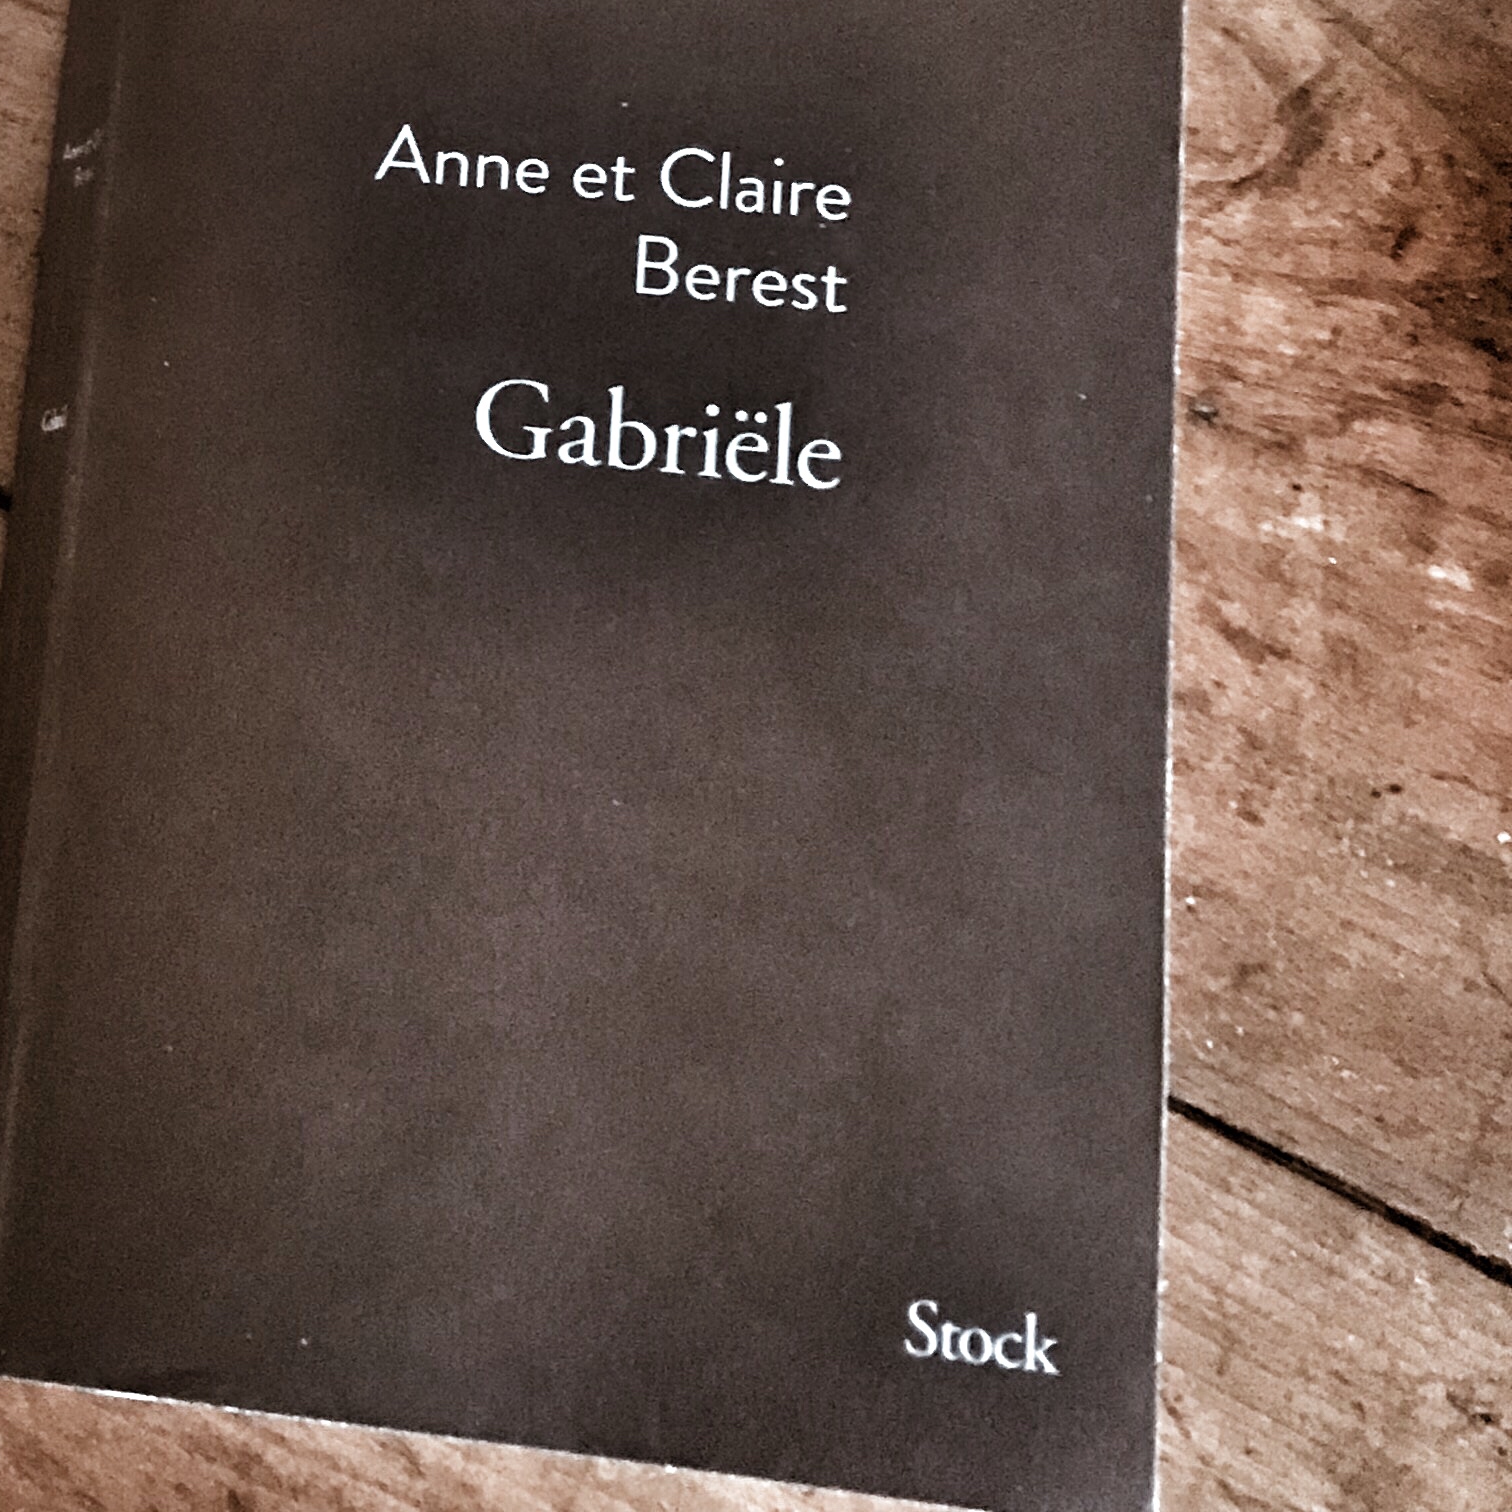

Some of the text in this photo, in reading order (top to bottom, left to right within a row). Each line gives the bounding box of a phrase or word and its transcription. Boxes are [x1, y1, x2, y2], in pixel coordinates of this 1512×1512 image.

[373, 122, 853, 222] Anne et Claire
[634, 233, 849, 314] Berest
[474, 378, 843, 491] Gabriële
[903, 1298, 1062, 1377] Stock
